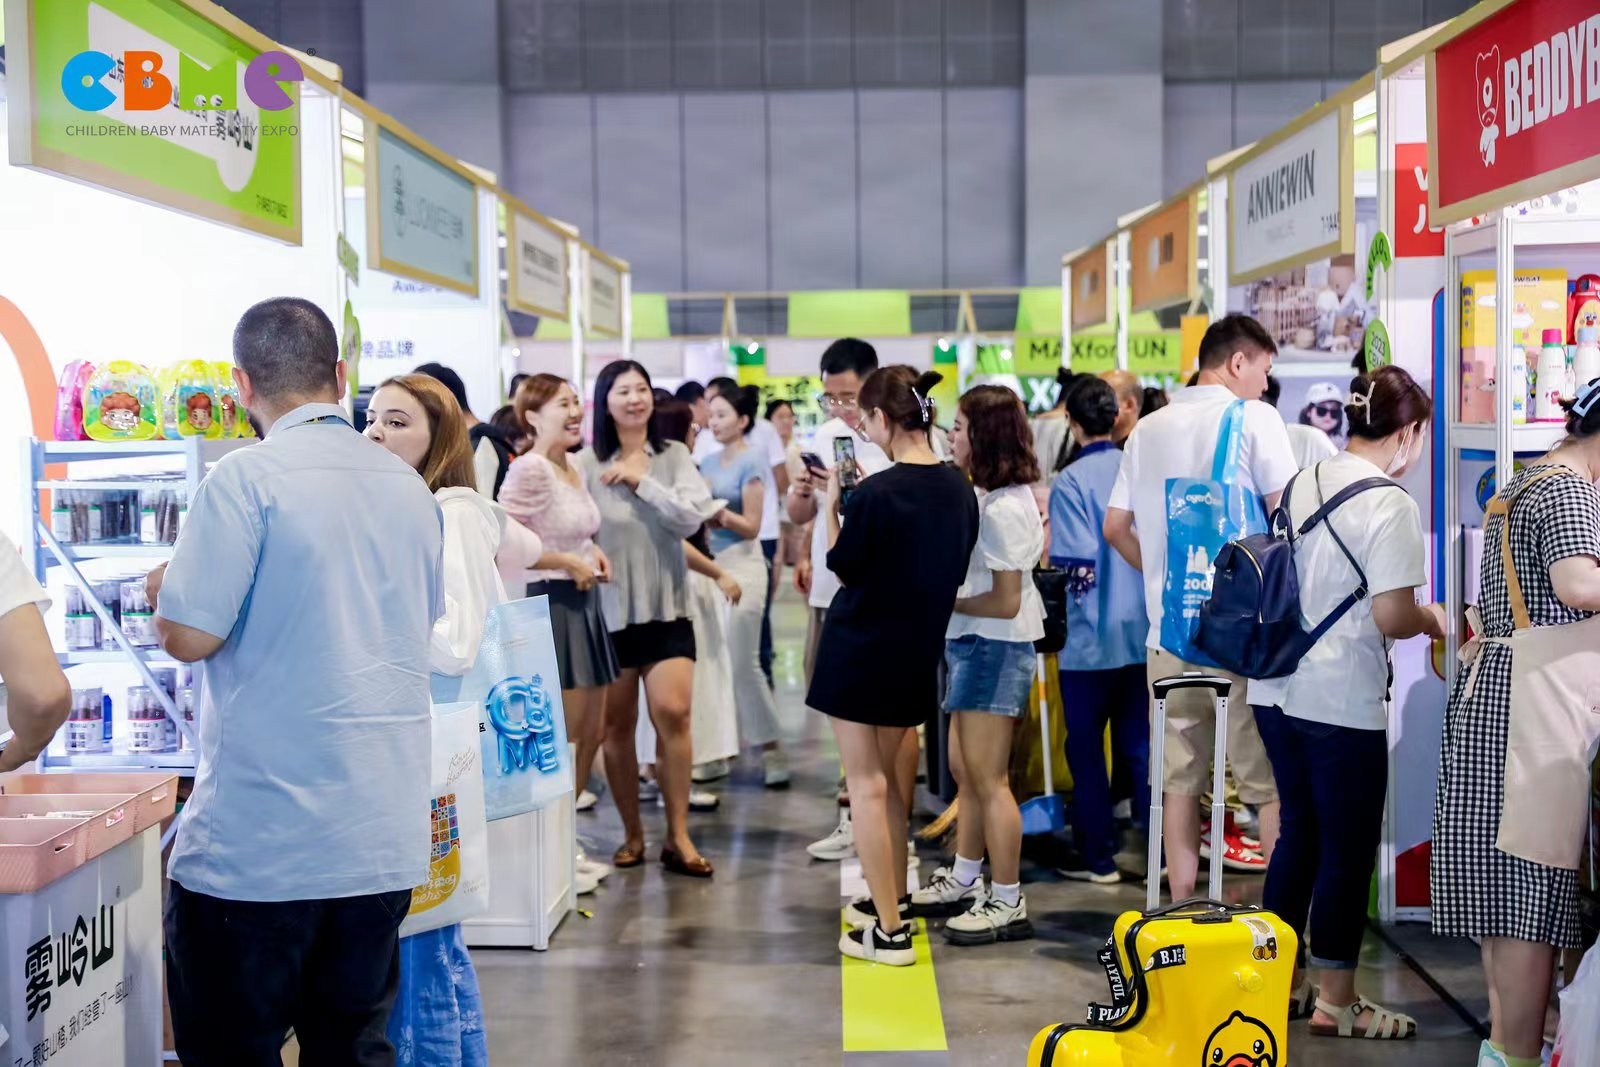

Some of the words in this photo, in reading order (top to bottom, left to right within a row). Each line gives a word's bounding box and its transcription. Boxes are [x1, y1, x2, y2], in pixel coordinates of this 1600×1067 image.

[1247, 148, 1315, 225] ANNIEWIN
[25, 904, 114, 1023] 雾岭山
